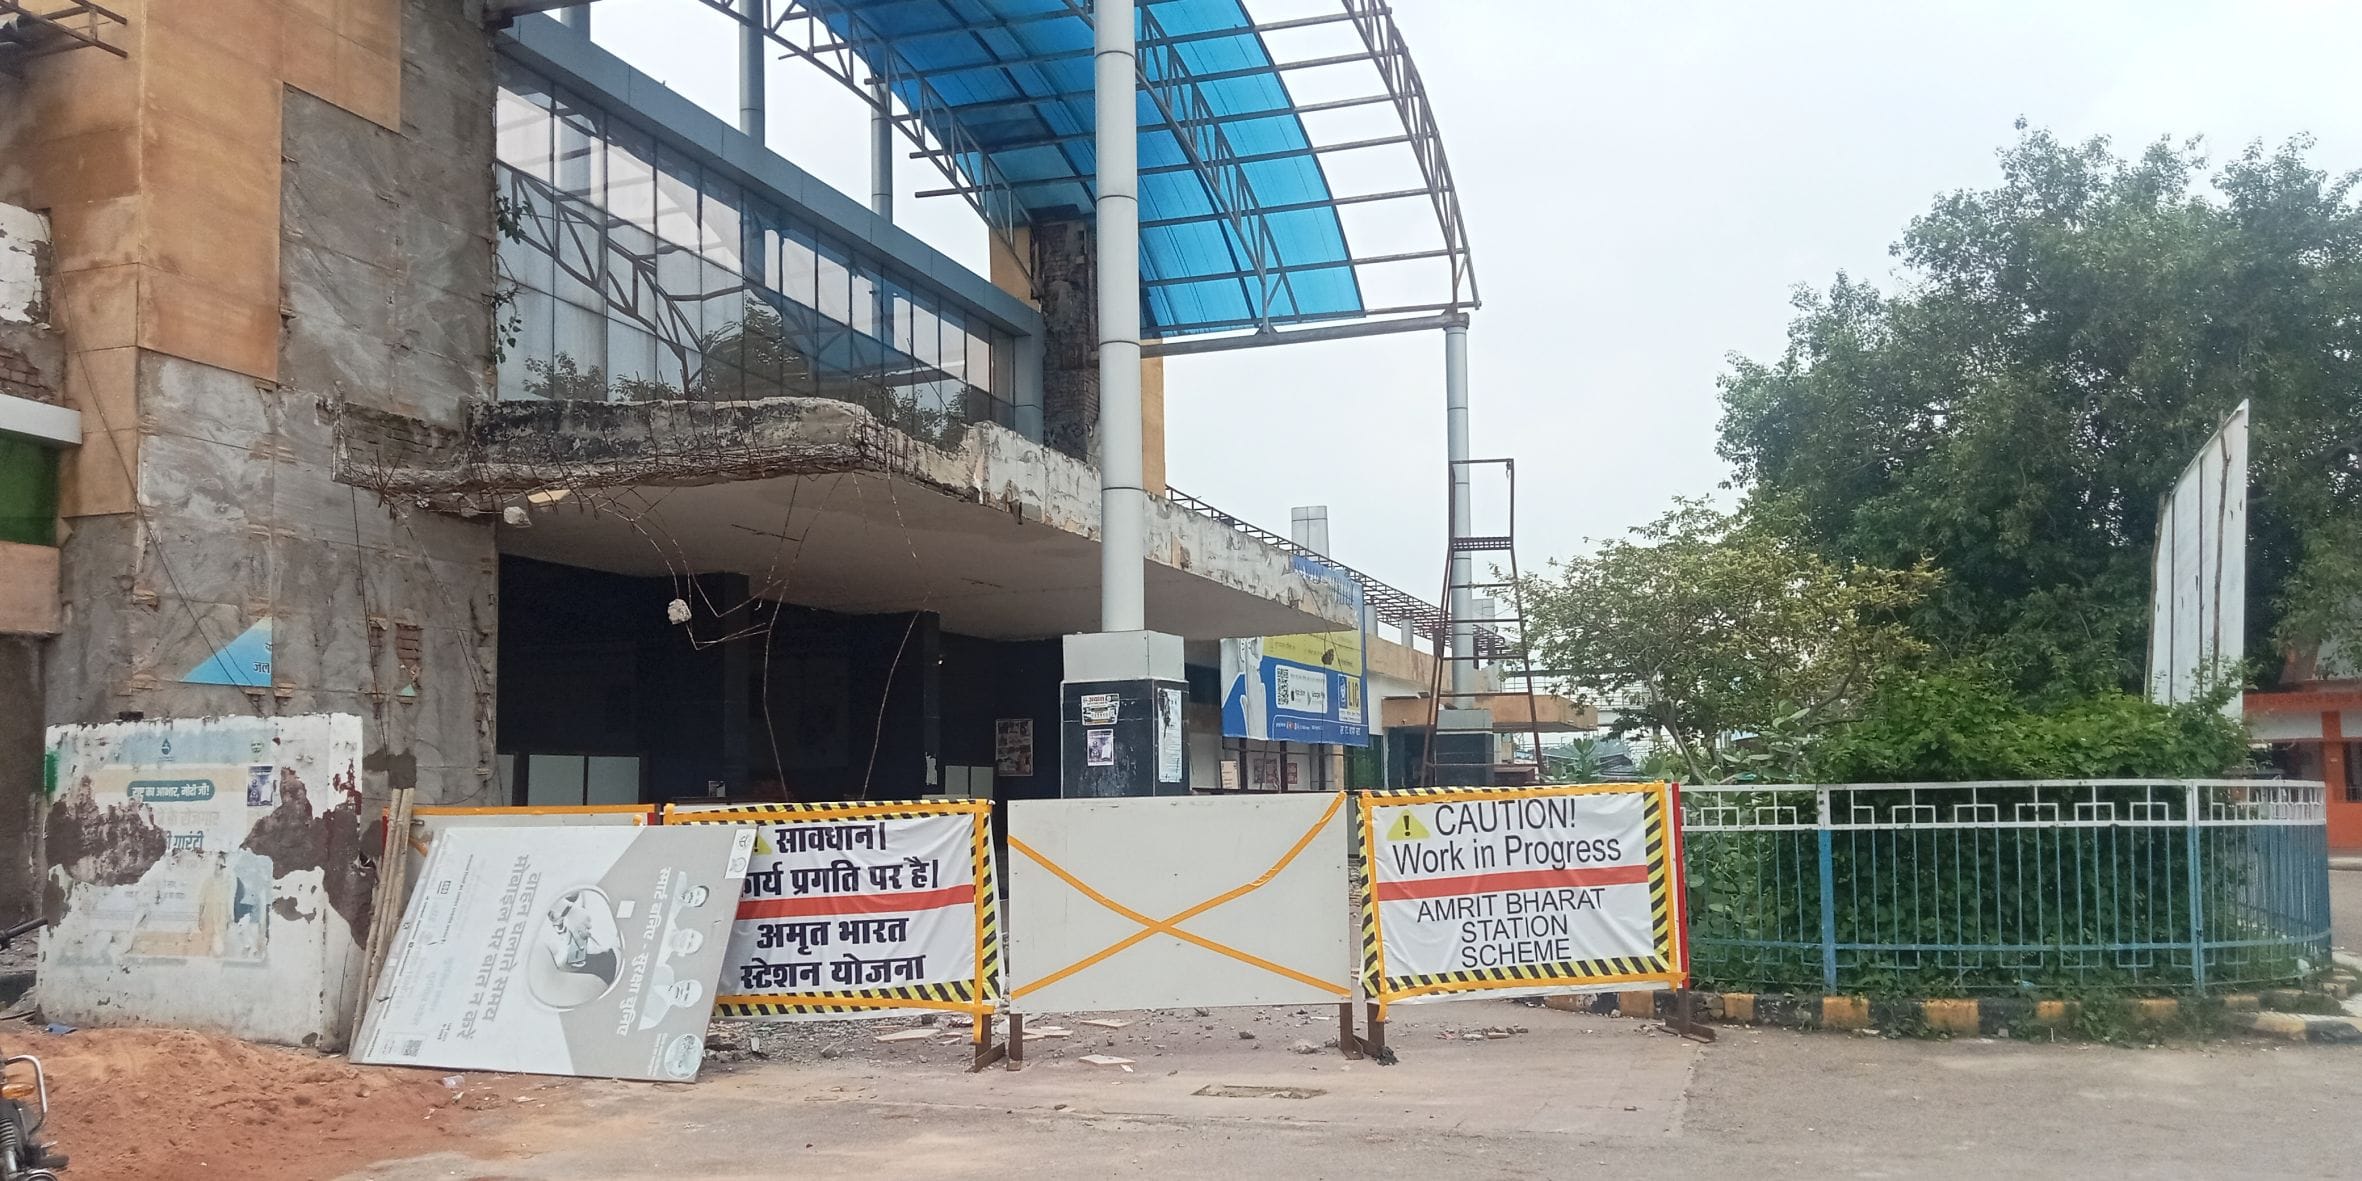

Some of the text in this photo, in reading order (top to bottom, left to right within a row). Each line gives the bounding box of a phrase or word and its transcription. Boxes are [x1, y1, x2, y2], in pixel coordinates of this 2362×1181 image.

[1347, 680, 1360, 707] LIC
[1435, 798, 1576, 836] CAUTION!
[775, 821, 887, 854] सावधान।
[1392, 834, 1622, 876] Work in Progress
[790, 859, 861, 895] प्रगति
[868, 864, 903, 891] पर
[904, 856, 939, 889] है।
[1416, 888, 1606, 923] AMRIT BHARAT
[457, 854, 531, 1040] मोबाइल पर बात न करें
[482, 872, 541, 1022] वाहन चलाते समय
[756, 917, 909, 955] अमृत भारत
[1461, 914, 1569, 943] STATION
[740, 953, 926, 989] स्टेशन योजना
[1461, 938, 1572, 968] SCHEME
